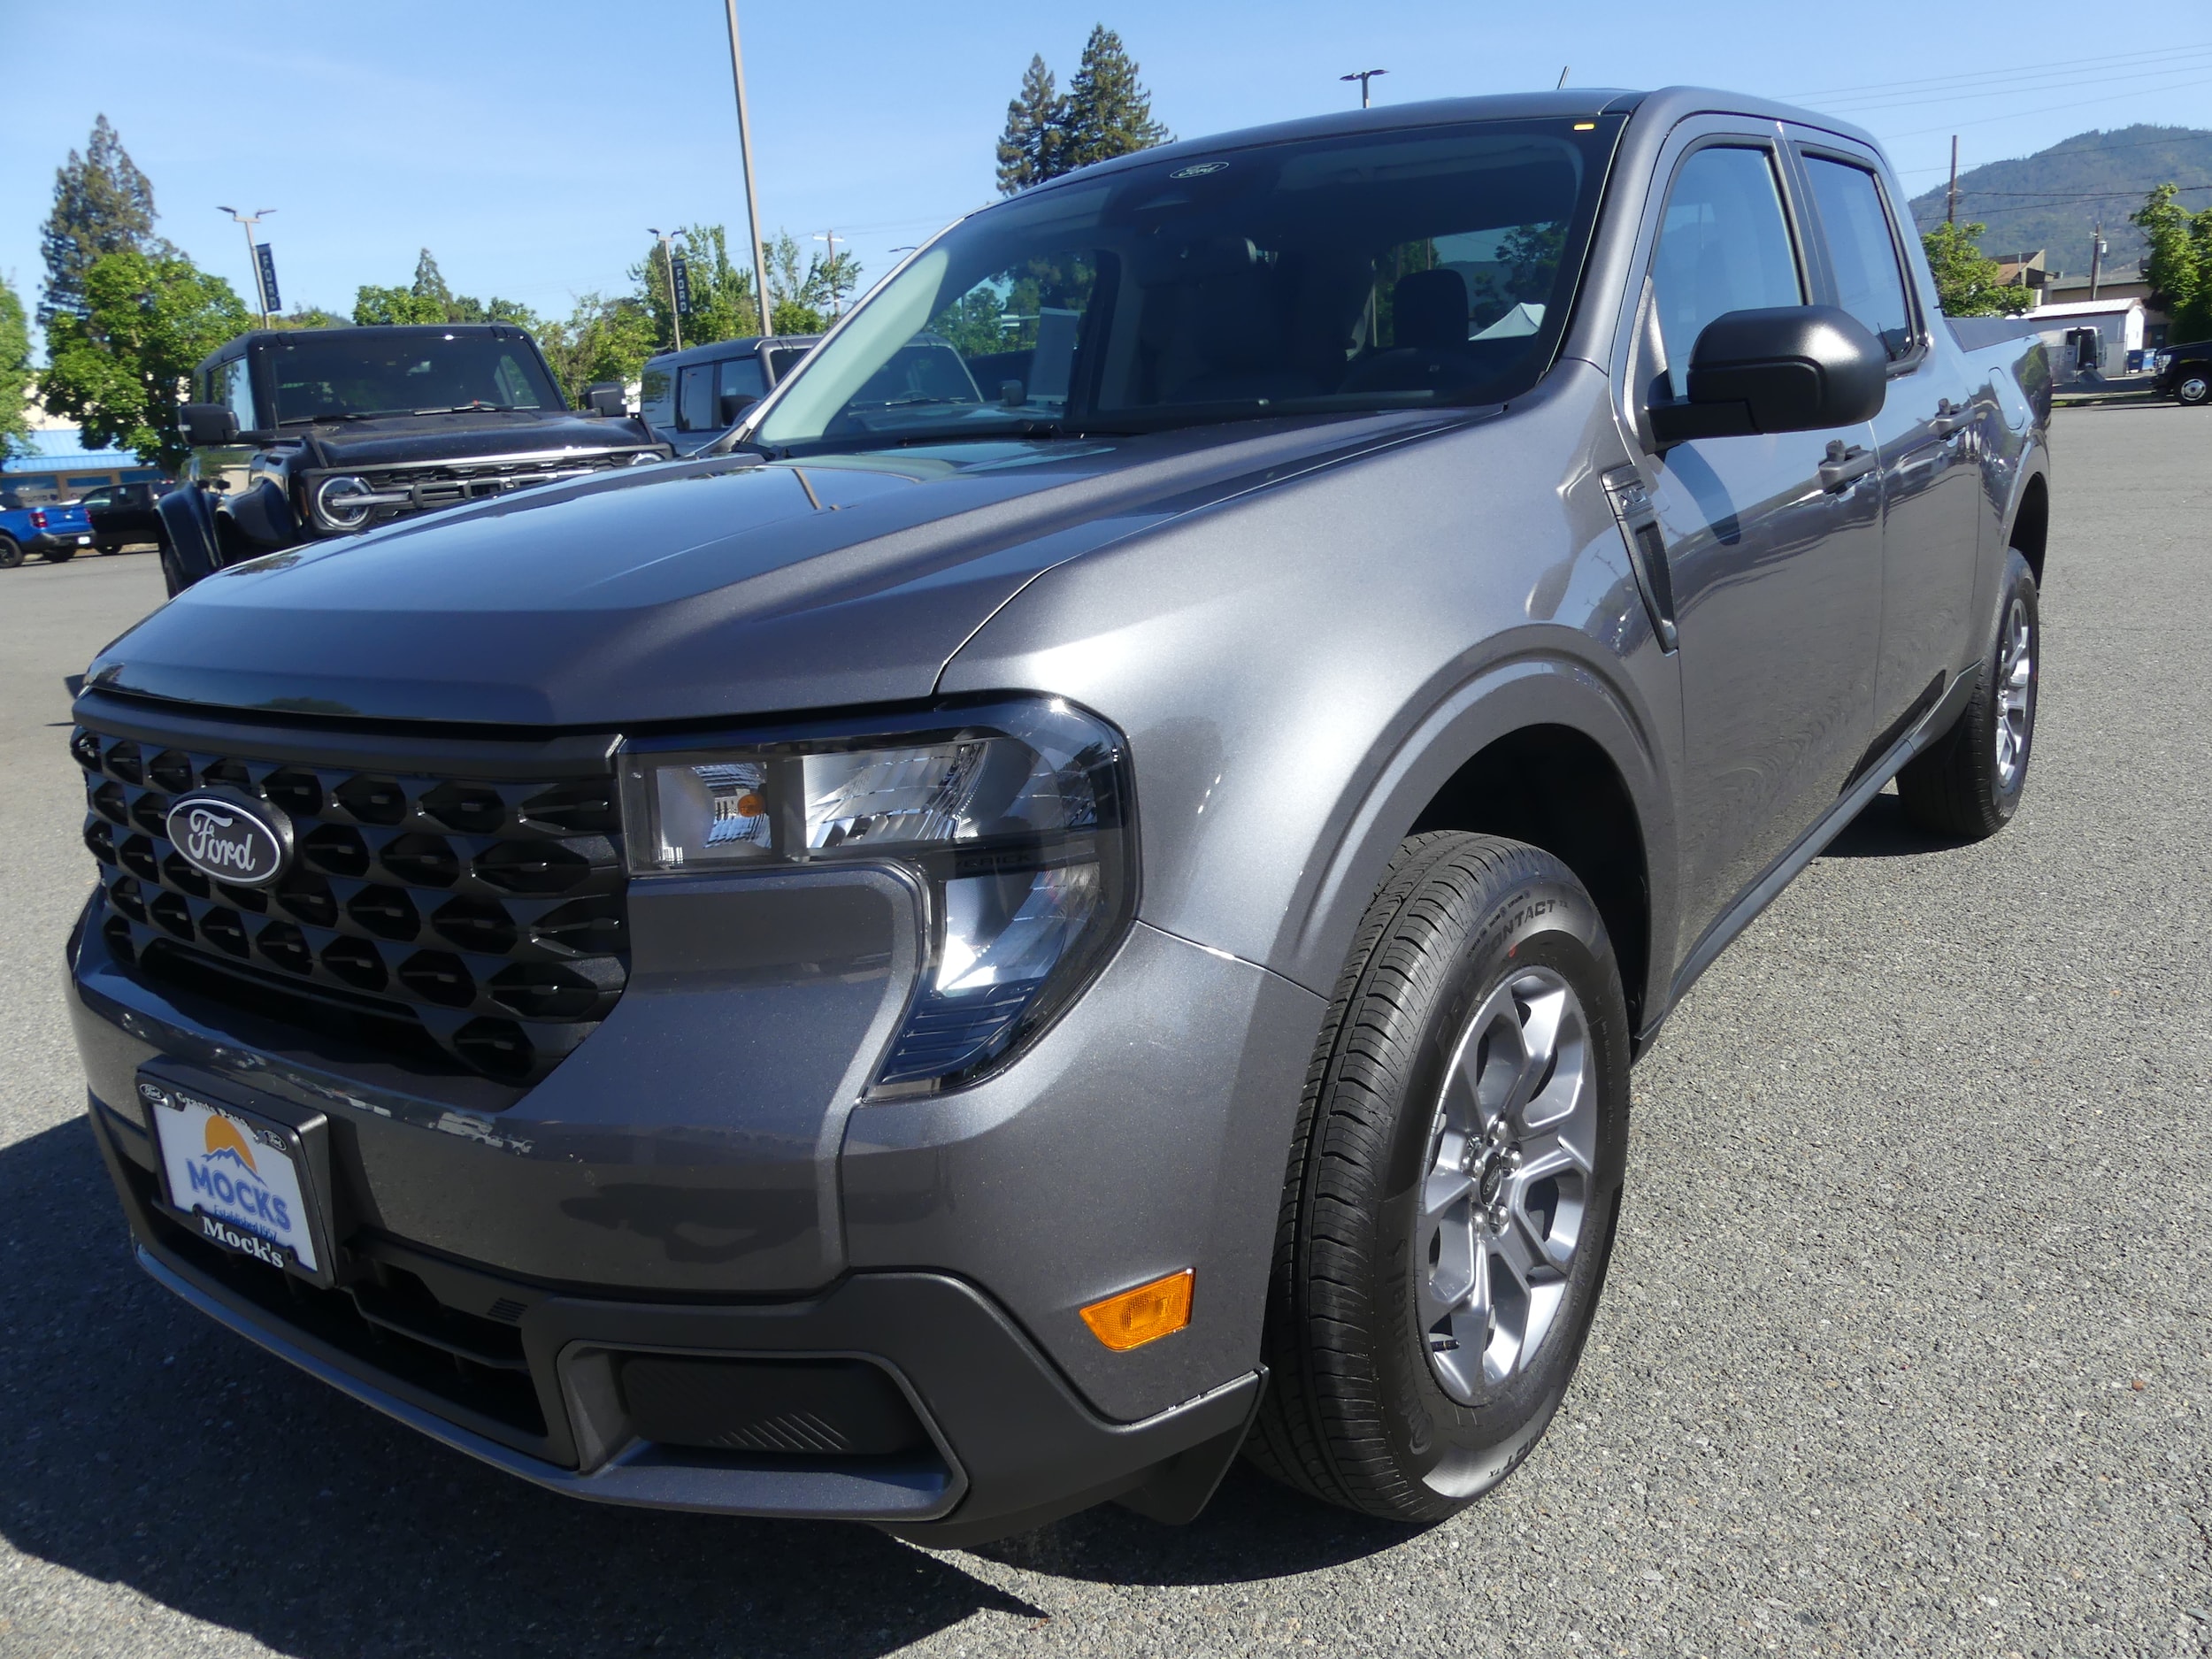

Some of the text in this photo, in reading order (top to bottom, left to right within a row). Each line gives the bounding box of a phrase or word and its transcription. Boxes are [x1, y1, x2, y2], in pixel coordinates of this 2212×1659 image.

[1178, 163, 1219, 177] Ford
[262, 255, 278, 310] FORD
[676, 268, 687, 312] FORD
[188, 809, 256, 872] Ford
[186, 1158, 292, 1233] MOCKS
[202, 1216, 284, 1268] Mock's
